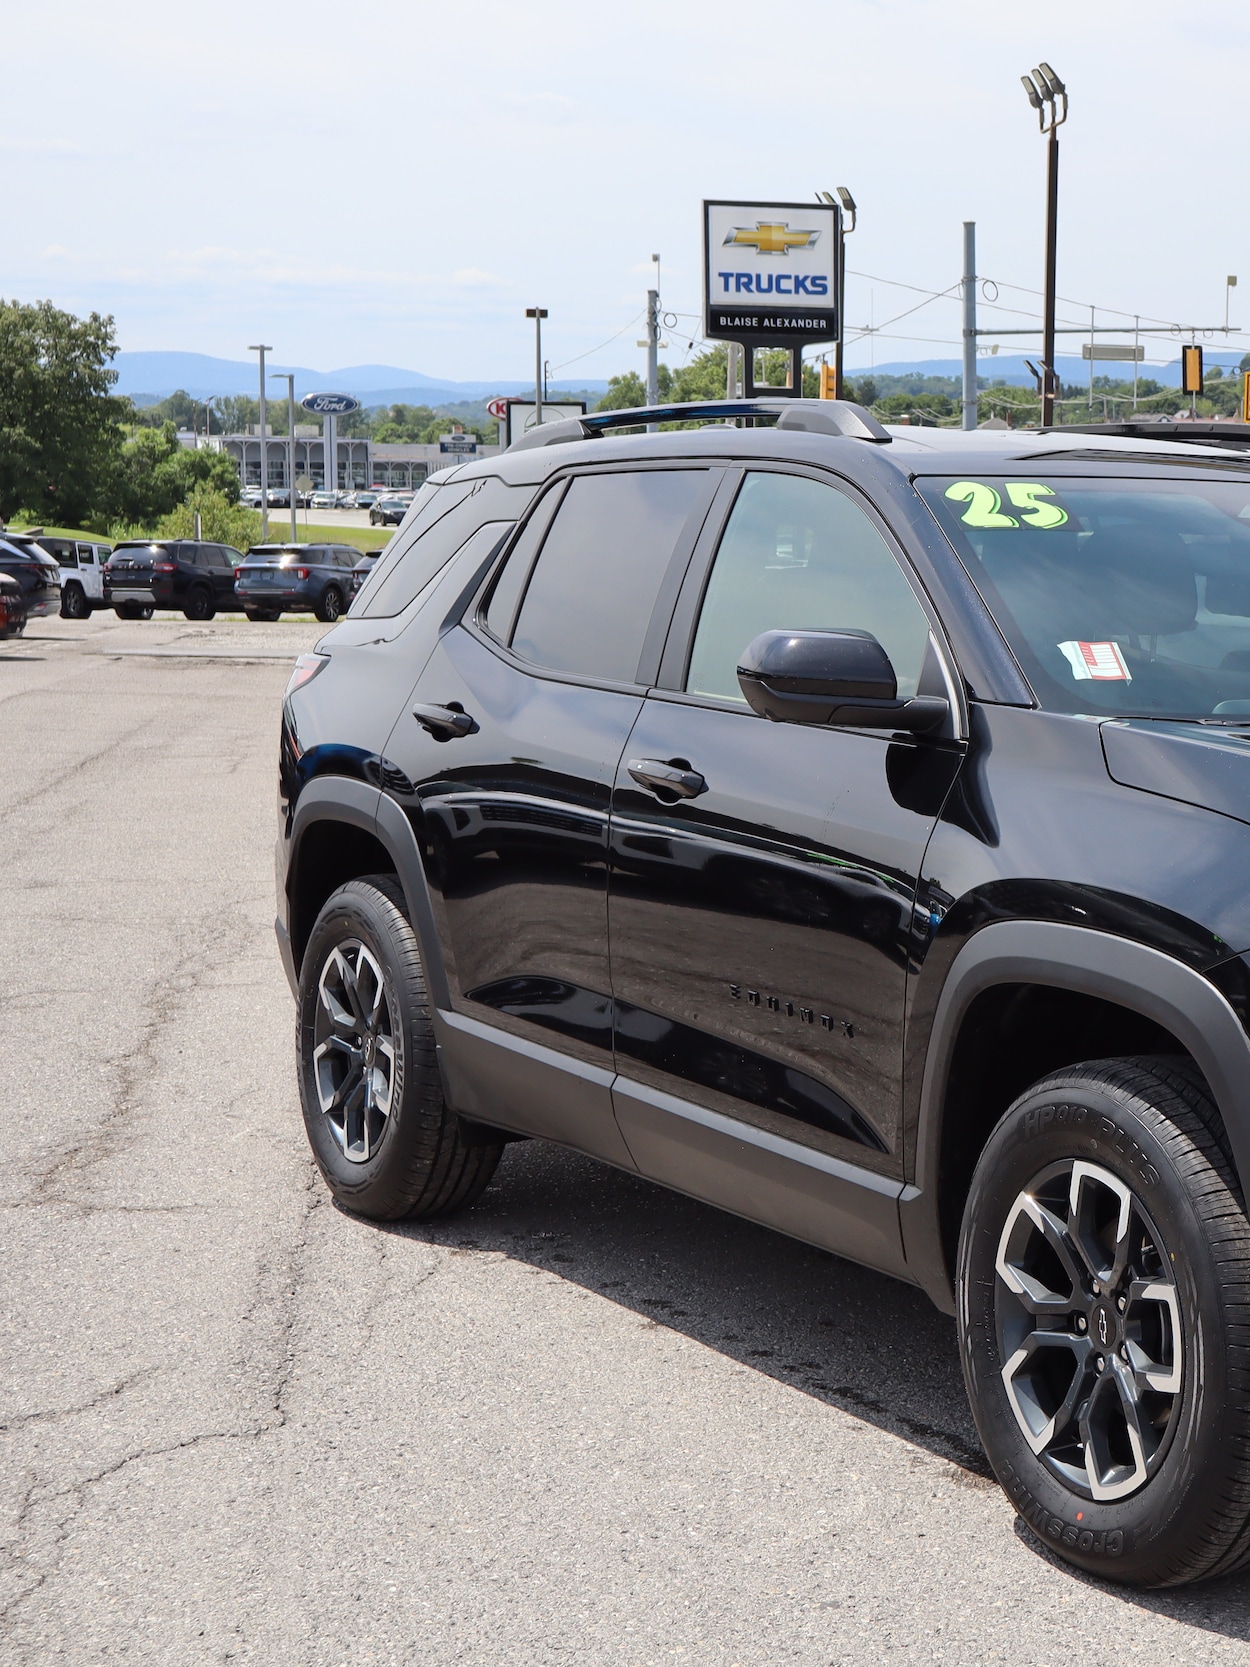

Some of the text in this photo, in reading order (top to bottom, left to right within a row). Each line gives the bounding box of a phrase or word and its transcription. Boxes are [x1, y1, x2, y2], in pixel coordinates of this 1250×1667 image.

[718, 272, 828, 295] TRUCKS
[719, 316, 827, 329] BLAISE ALEXANDER
[313, 396, 347, 411] Ford
[944, 481, 1069, 529] 25
